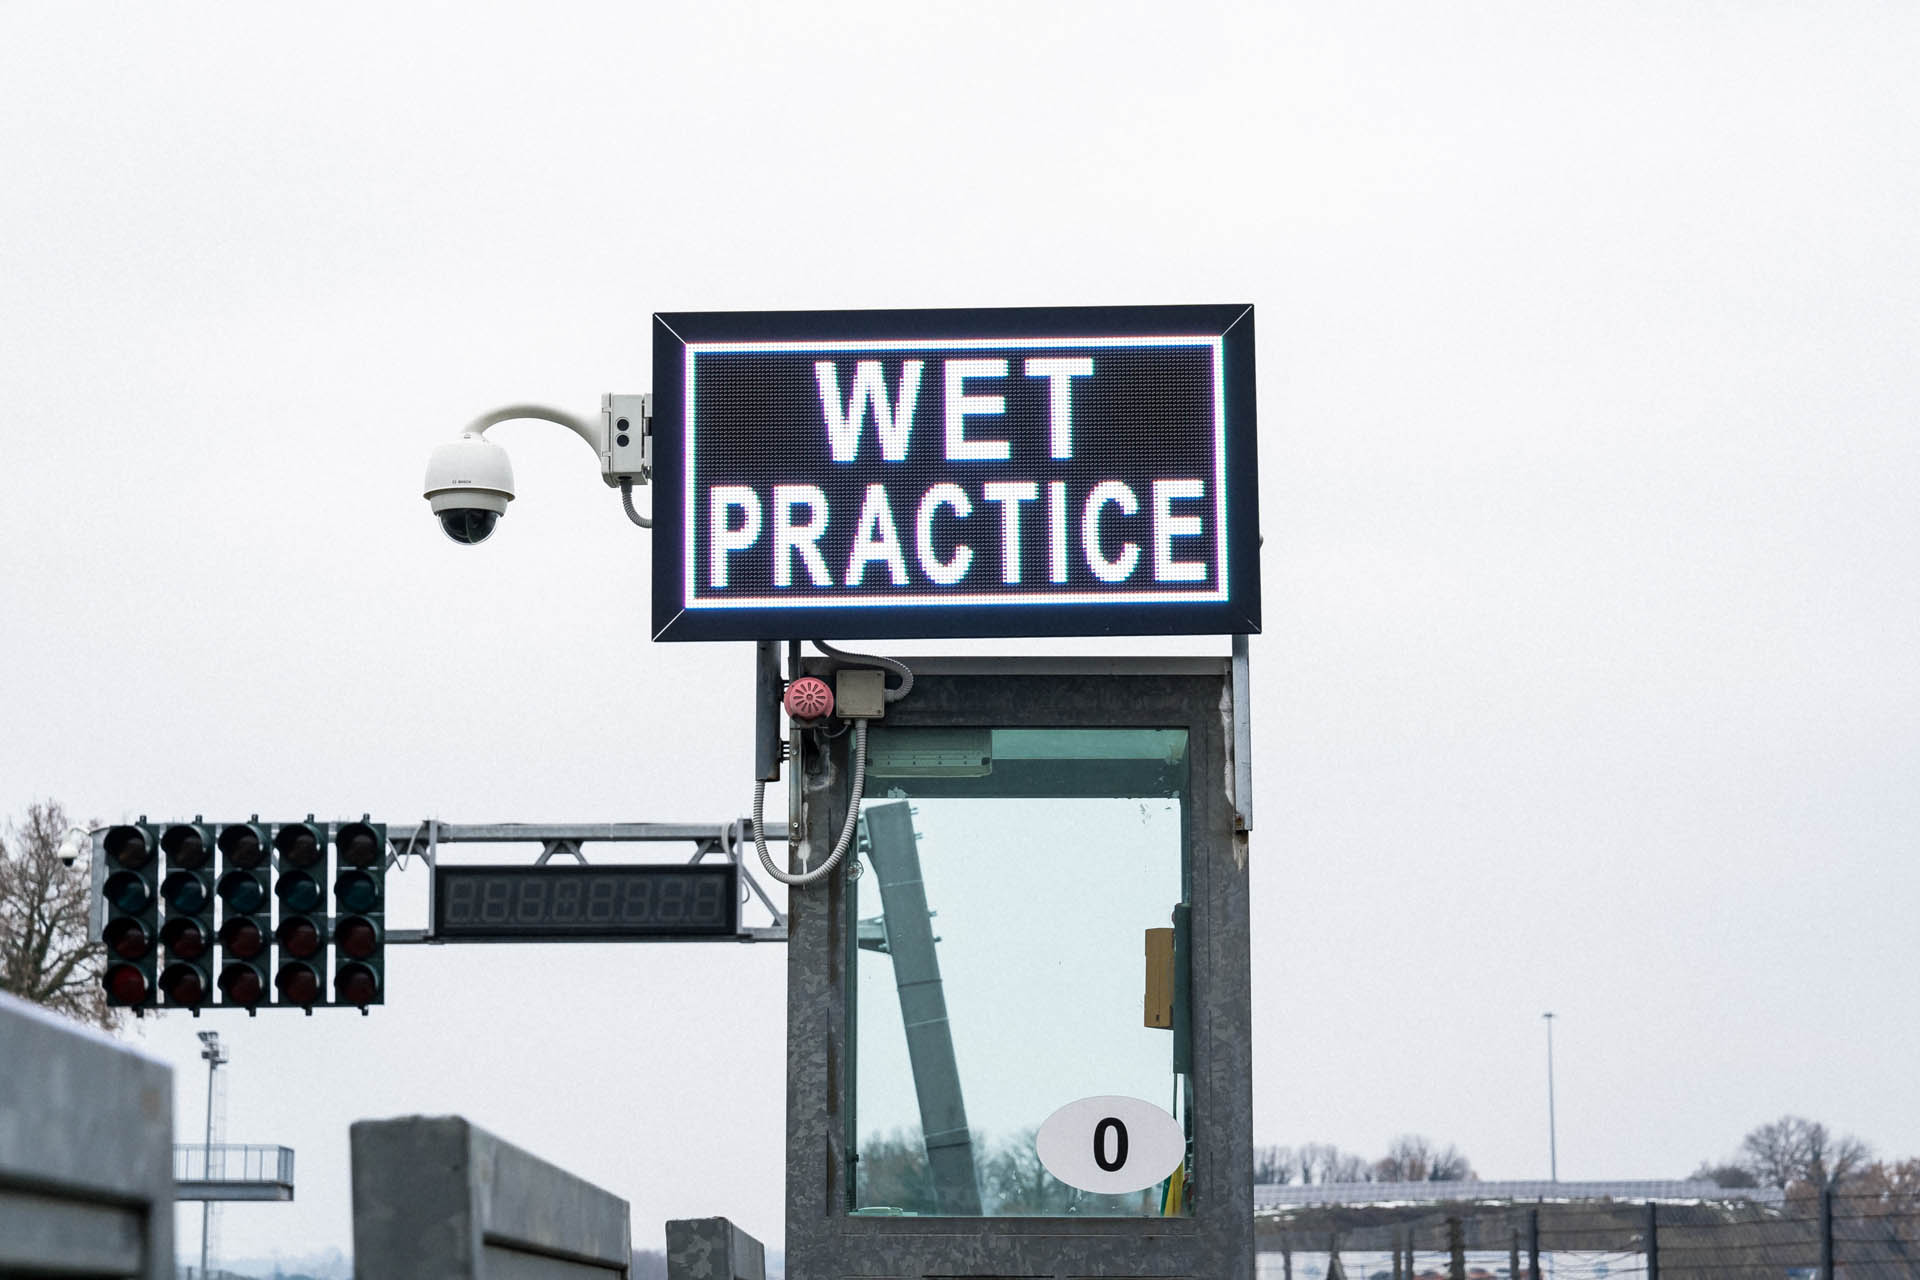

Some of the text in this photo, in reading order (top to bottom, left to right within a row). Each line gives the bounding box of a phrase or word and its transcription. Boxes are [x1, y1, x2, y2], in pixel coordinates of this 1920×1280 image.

[814, 357, 1094, 462] WET
[710, 479, 1207, 587] PRACTICE
[1093, 1117, 1129, 1173] 0
